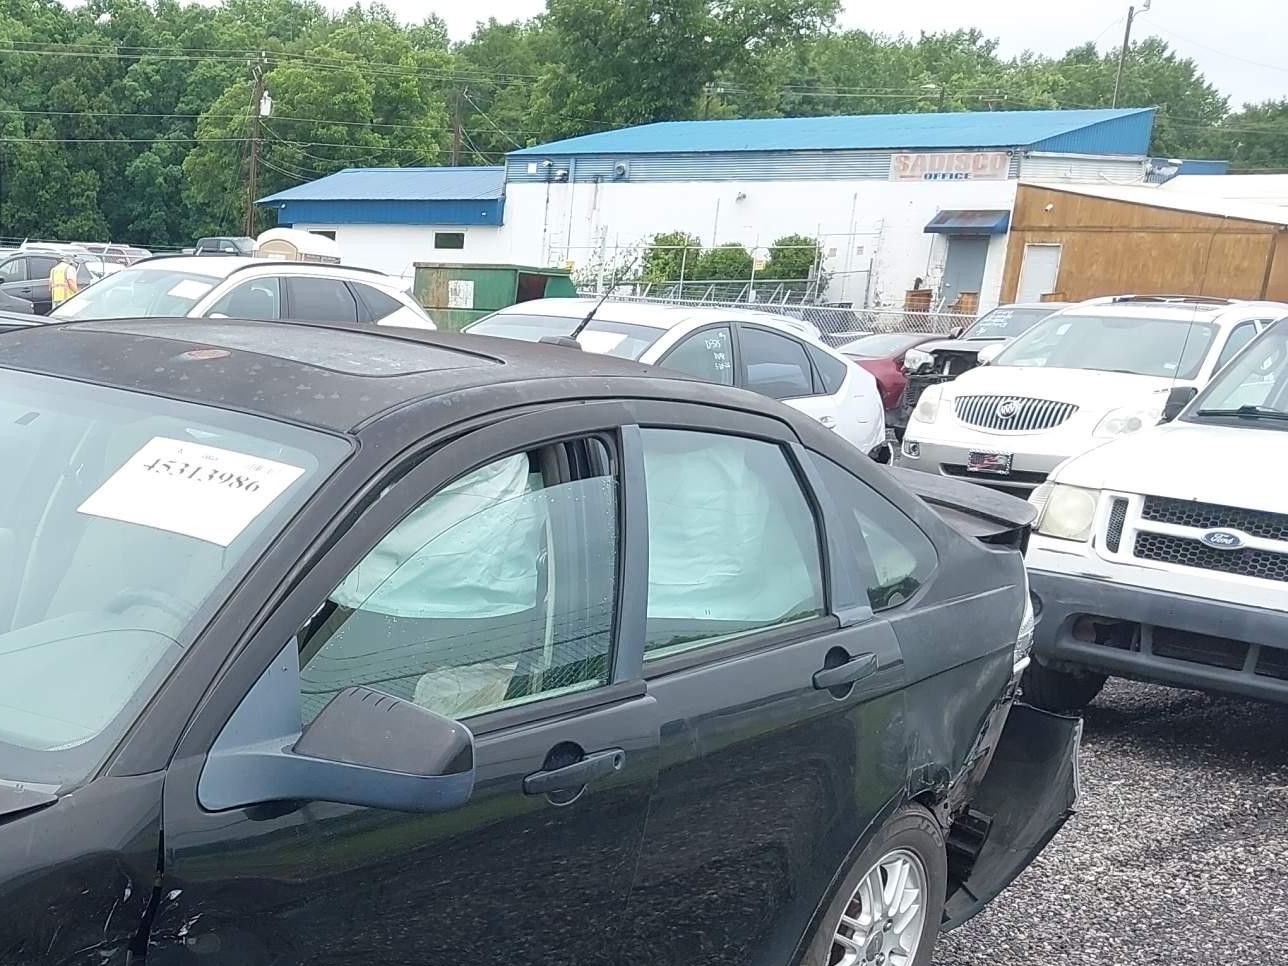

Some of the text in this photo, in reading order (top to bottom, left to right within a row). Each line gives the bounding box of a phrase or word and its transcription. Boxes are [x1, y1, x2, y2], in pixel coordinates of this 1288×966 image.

[895, 153, 1008, 173] SADISCO
[923, 172, 974, 180] OFFICE
[143, 458, 261, 493] 45313986
[1210, 533, 1234, 545] Ford
